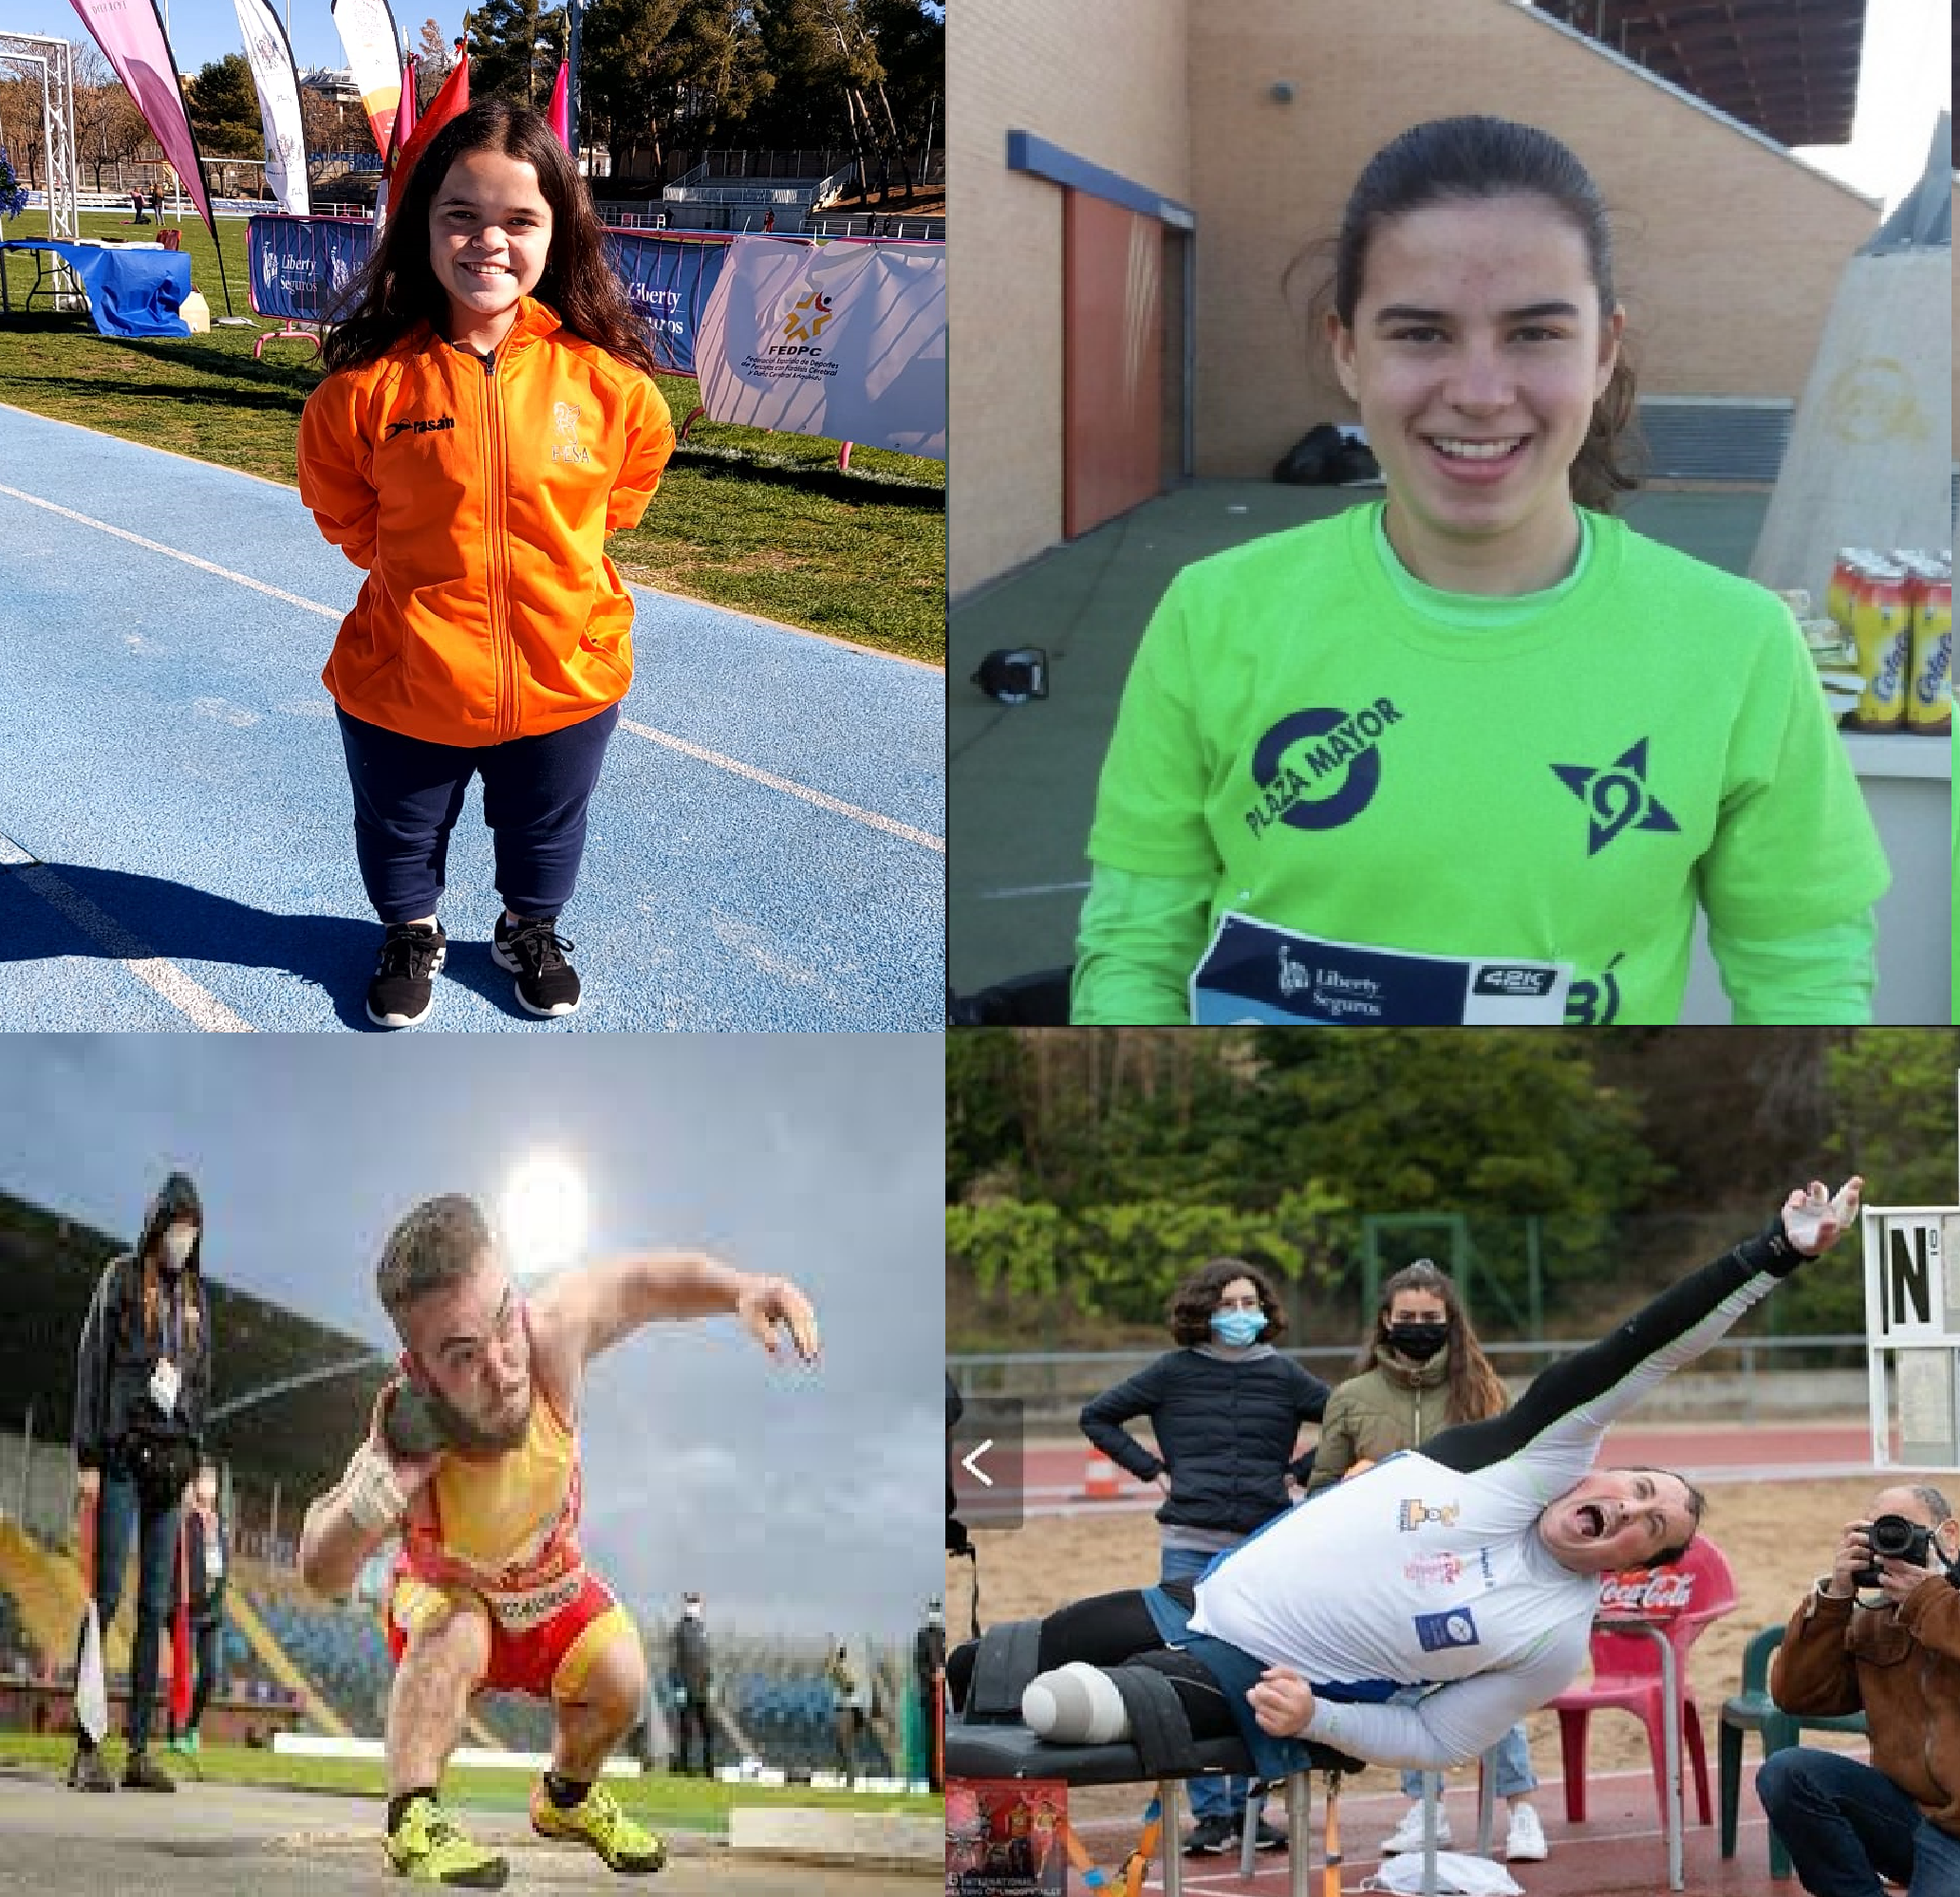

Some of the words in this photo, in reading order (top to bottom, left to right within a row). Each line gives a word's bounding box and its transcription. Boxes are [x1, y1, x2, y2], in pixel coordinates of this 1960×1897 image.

[281, 254, 317, 276] Liberty
[280, 274, 318, 295] Seguros
[768, 345, 822, 356] FEDPC
[809, 367, 837, 376] Cerebral
[810, 360, 839, 369] Deportes
[1244, 768, 1312, 842] PLAZA
[1303, 697, 1405, 778] MAYOR
[1316, 968, 1380, 998] Liberty
[1313, 991, 1382, 1016] Seguros
